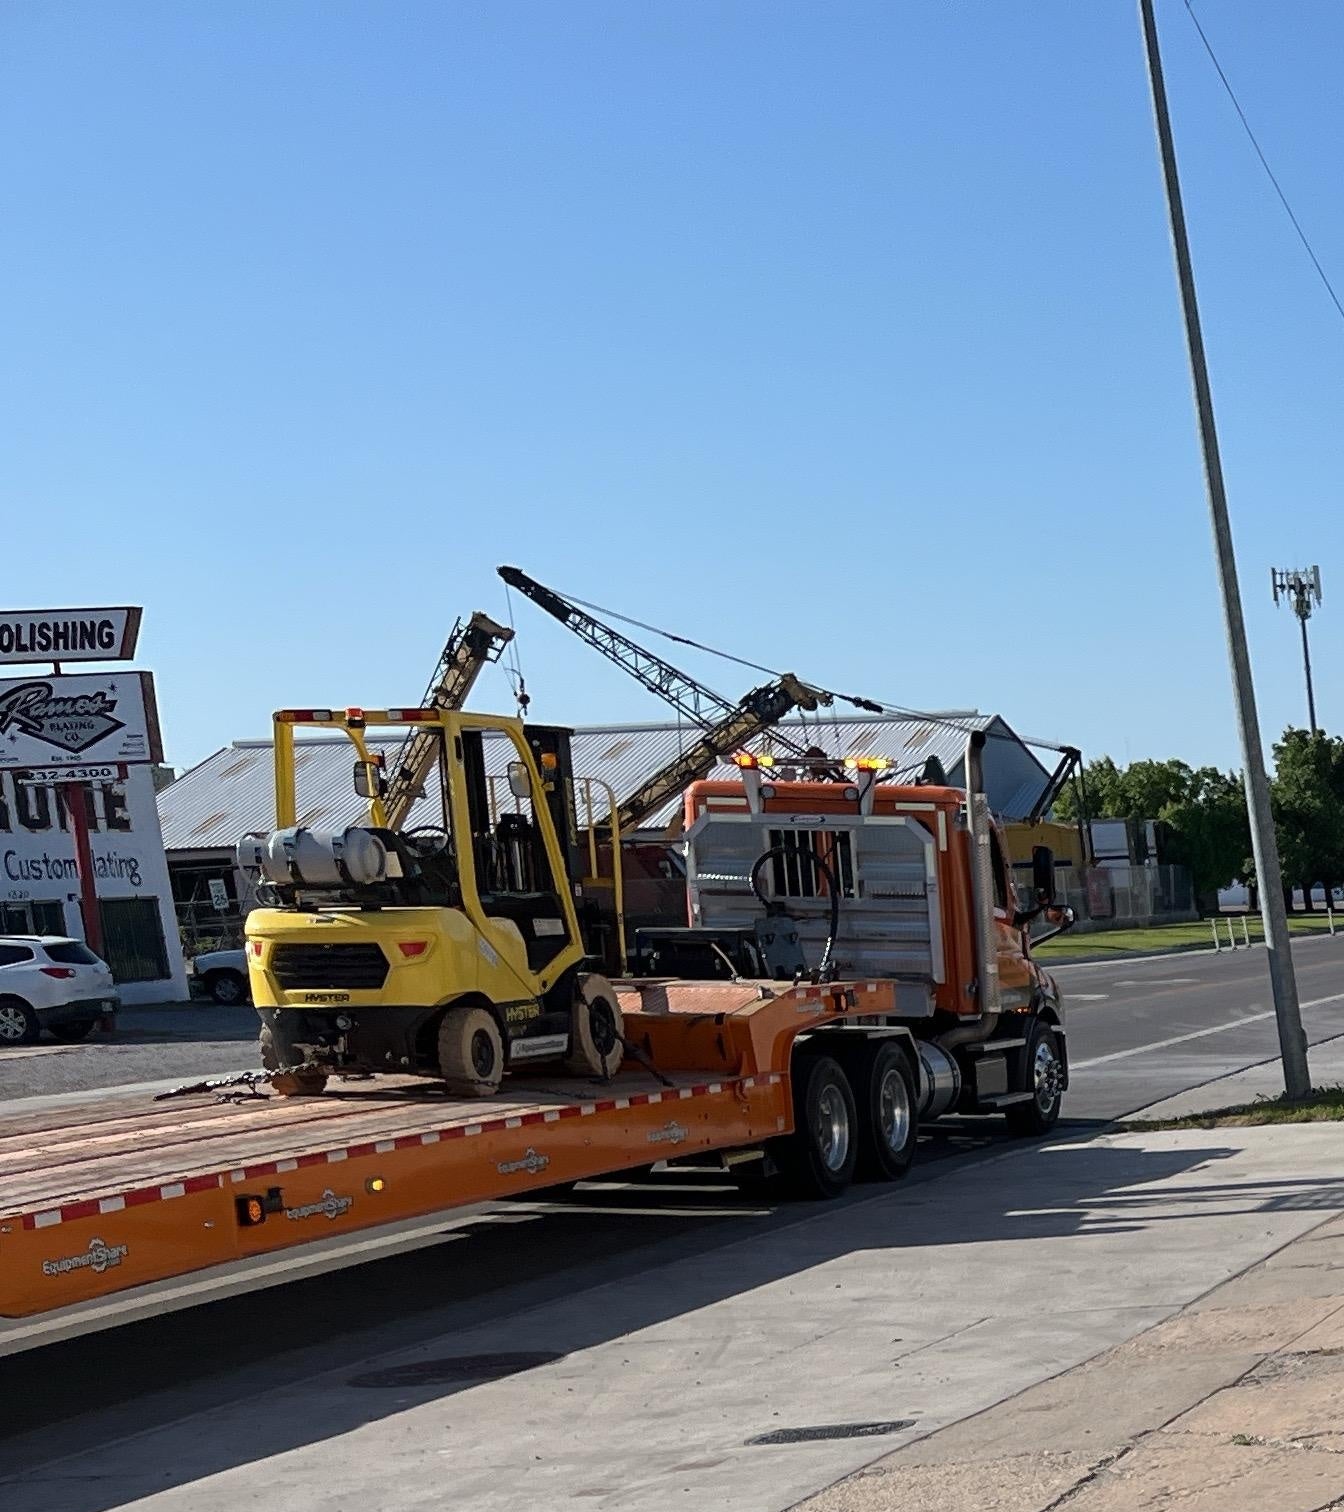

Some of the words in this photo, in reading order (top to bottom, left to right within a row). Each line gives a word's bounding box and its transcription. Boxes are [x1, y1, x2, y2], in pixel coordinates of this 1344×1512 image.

[0, 620, 115, 653] OLISHING
[50, 721, 95, 732] PLATING
[4, 849, 79, 881] Custom
[90, 849, 143, 887] lating
